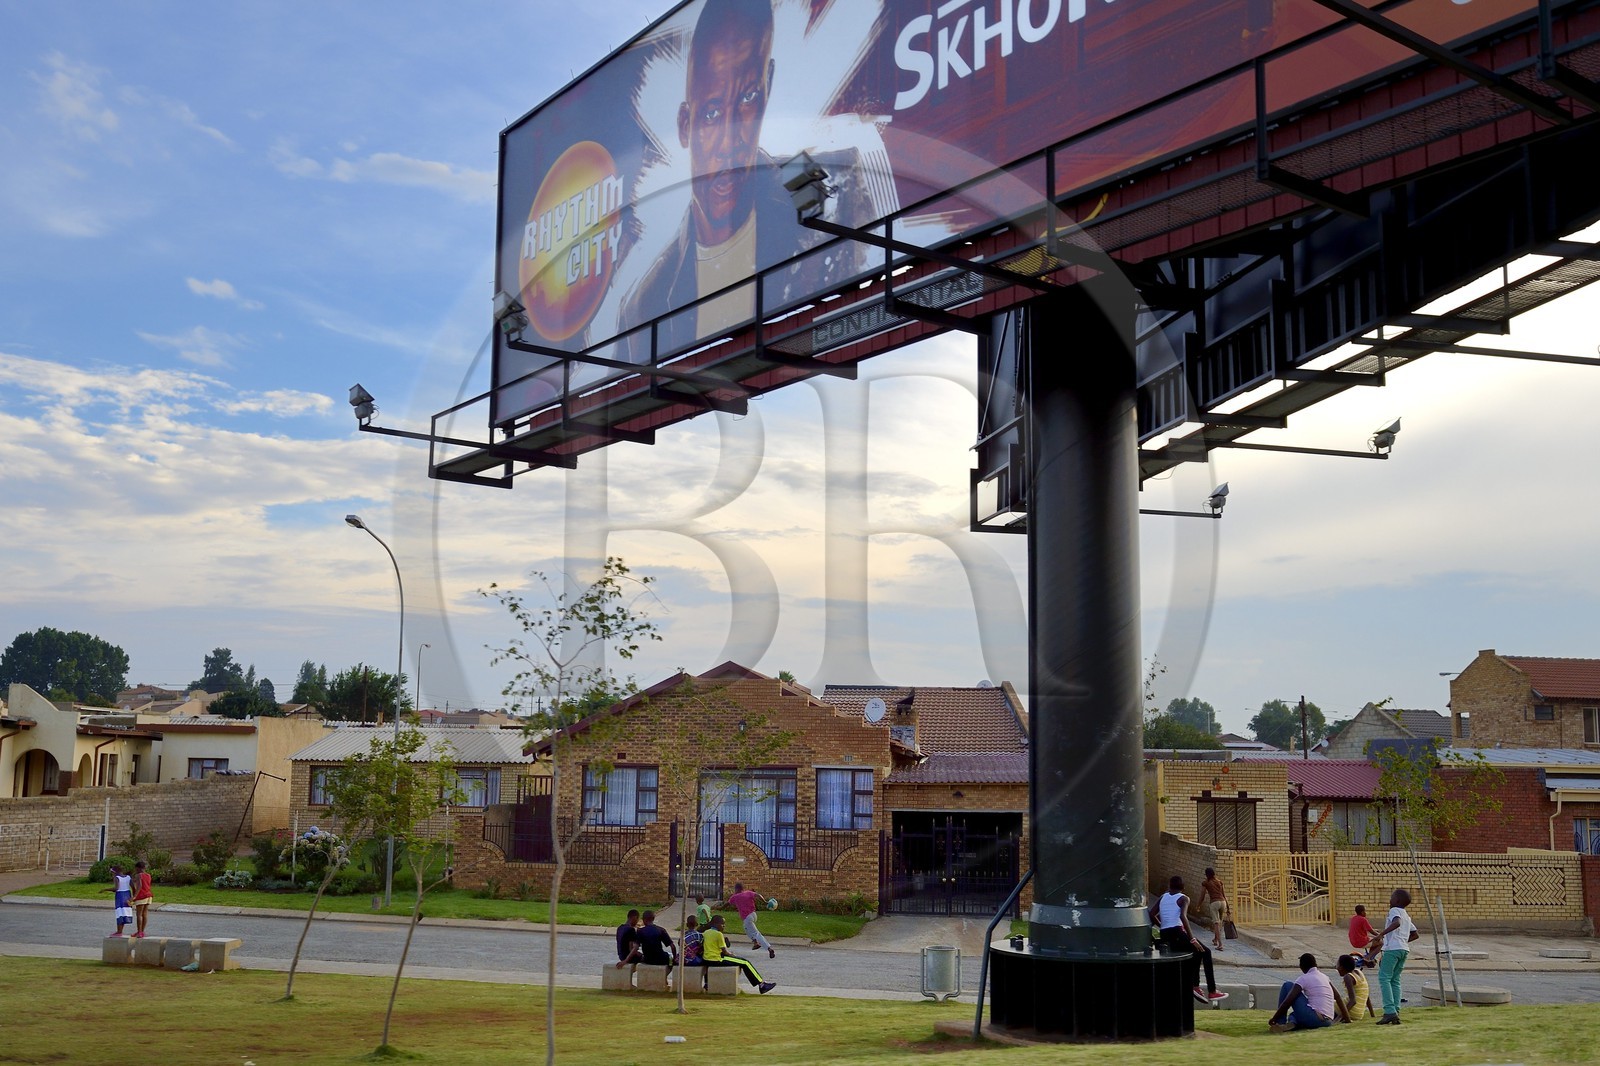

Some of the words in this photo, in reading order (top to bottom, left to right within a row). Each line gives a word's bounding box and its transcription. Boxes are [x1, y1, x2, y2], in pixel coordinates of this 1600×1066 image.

[523, 174, 624, 261] RHYTHM
[566, 219, 623, 287] CITY
[814, 272, 981, 343] CONTINTAL
